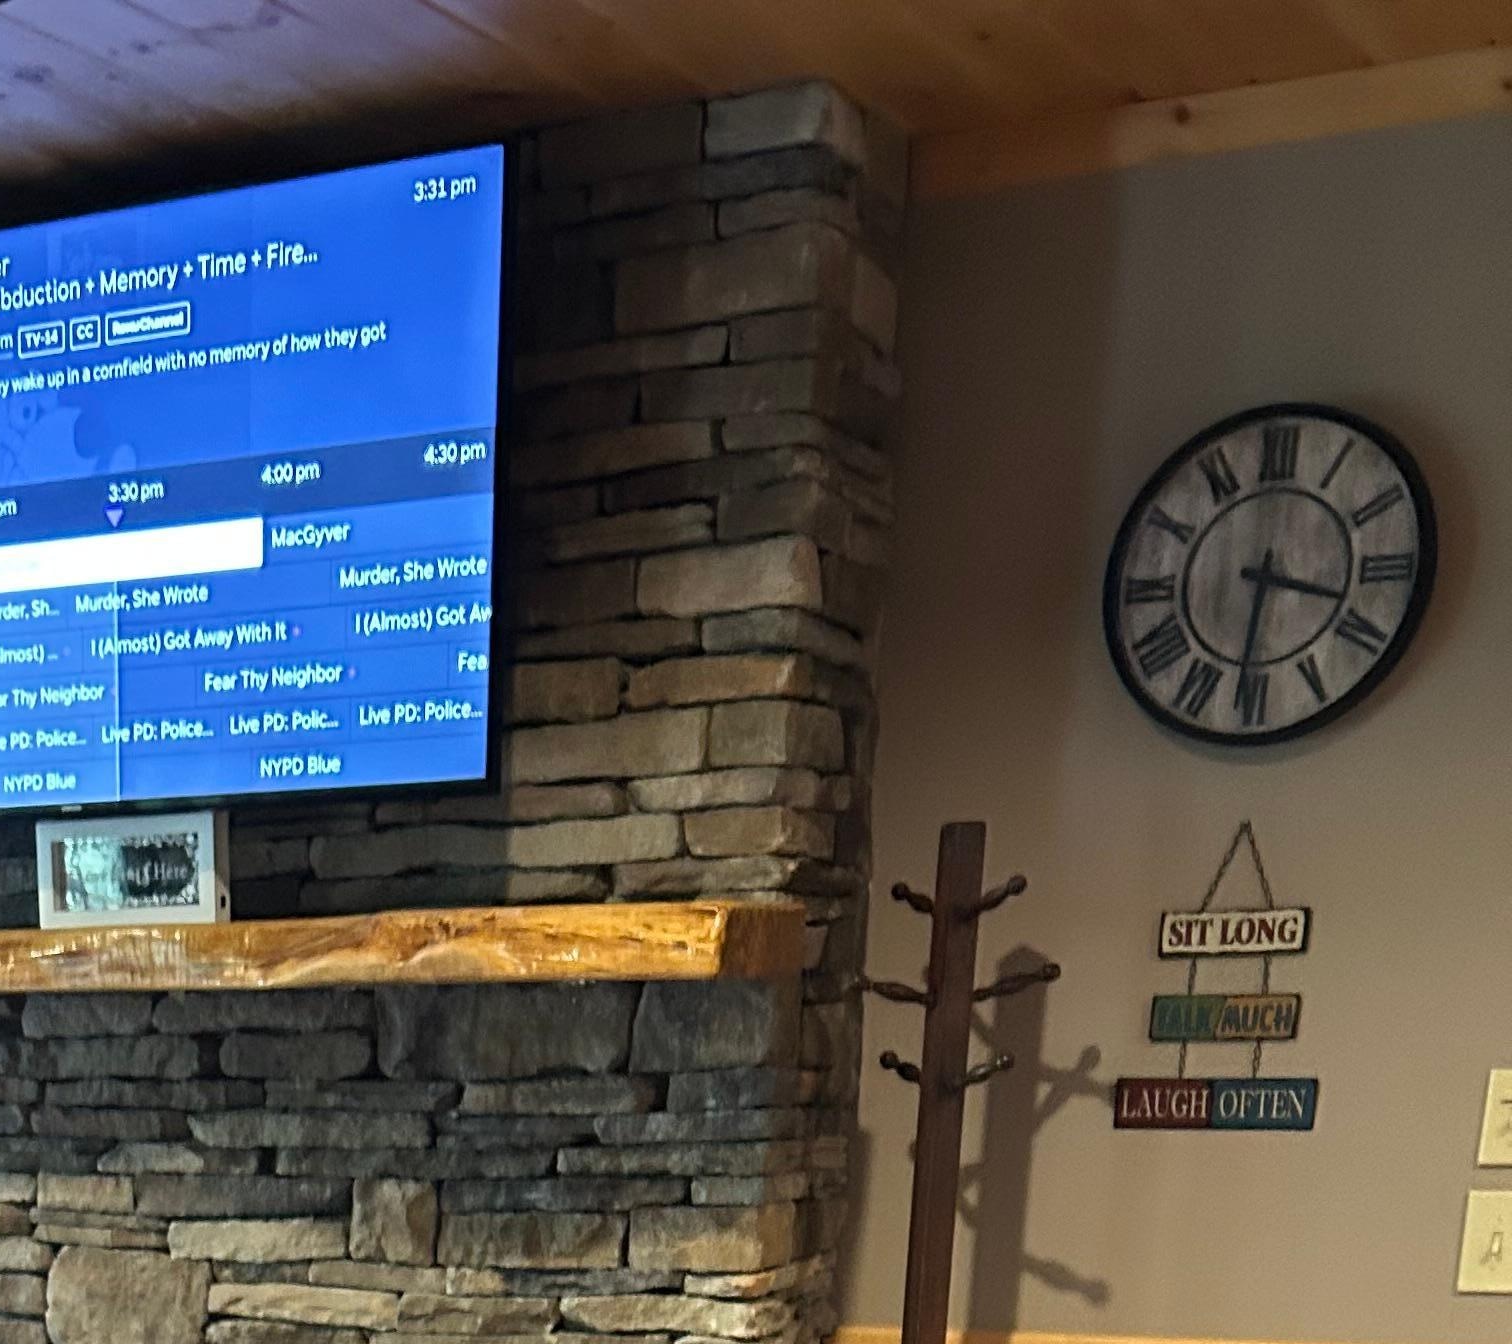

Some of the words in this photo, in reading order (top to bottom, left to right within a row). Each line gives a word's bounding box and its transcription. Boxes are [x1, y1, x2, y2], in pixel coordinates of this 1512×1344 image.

[414, 177, 447, 202] 3:31
[451, 175, 476, 200] pm
[99, 263, 178, 296] Memory
[198, 252, 246, 279] Time
[76, 323, 94, 339] CC
[12, 370, 44, 392] wake
[47, 372, 65, 390] up
[67, 366, 79, 384] in
[82, 367, 90, 382] a
[93, 354, 152, 382] cornfield
[155, 351, 186, 373] with
[189, 350, 206, 368] no
[210, 340, 270, 365] memory
[273, 334, 288, 356] of
[291, 333, 321, 352] how
[324, 327, 358, 349] they
[361, 320, 386, 347] got
[424, 443, 457, 465] 4:30
[461, 442, 486, 465] pm
[261, 464, 293, 484] 4:00
[296, 462, 320, 484] pm
[109, 482, 138, 503] 3:30
[141, 482, 164, 502] pm
[271, 524, 350, 549] MacGyver
[339, 565, 400, 589] Murder,
[404, 560, 434, 582] She
[437, 555, 487, 579] Wrote
[76, 592, 130, 613] Murder,
[133, 587, 160, 607] She
[163, 585, 208, 605] Wrote
[355, 613, 360, 635] I
[364, 608, 433, 637] (Almost)
[436, 605, 466, 626] Got
[91, 639, 95, 656] I
[164, 628, 191, 650] Got
[194, 627, 233, 650] Away
[237, 622, 271, 644] With
[275, 622, 287, 640] It
[204, 673, 237, 692] Fear
[240, 667, 269, 692] Thy
[272, 663, 343, 689] Neighbor
[12, 688, 37, 709] Thy
[41, 685, 104, 707] Neighbor
[230, 715, 260, 735] Live
[263, 713, 289, 733] PD:
[359, 705, 390, 726] Live
[394, 703, 421, 724] PD:
[10, 732, 33, 750] PD:
[101, 725, 129, 744] Live
[133, 722, 157, 742] PD:
[260, 757, 303, 778] NYPD
[308, 755, 341, 775] Blue
[3, 775, 43, 793] NYPD
[46, 773, 76, 789] Blue
[1168, 918, 1213, 947] SIT
[1219, 915, 1298, 946] LONG
[1221, 1003, 1293, 1032] MUCH
[1121, 1088, 1211, 1120] LAUGH
[1219, 1088, 1307, 1120] OFTEN
